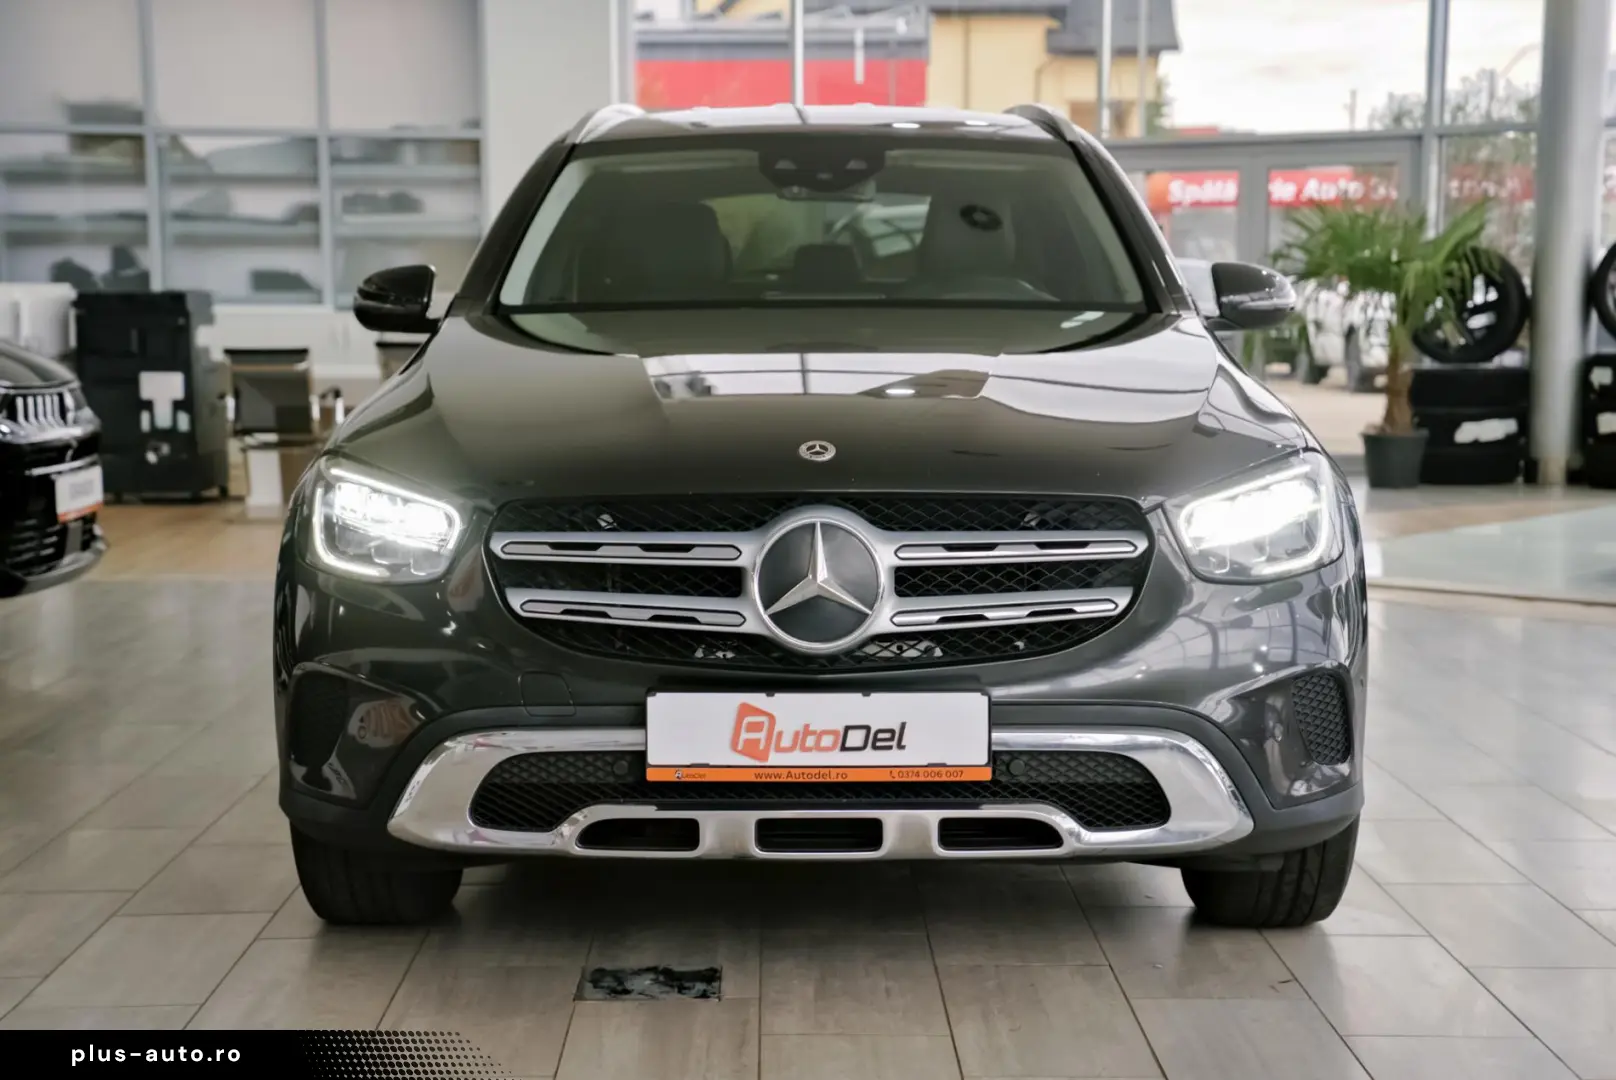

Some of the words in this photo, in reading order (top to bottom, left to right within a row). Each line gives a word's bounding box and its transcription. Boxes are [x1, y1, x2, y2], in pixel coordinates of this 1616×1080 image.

[731, 706, 907, 759] AutoDel
[753, 770, 848, 780] www.Autodel.ro
[897, 769, 920, 779] 0374
[922, 769, 943, 779] 006
[945, 769, 964, 778] 007
